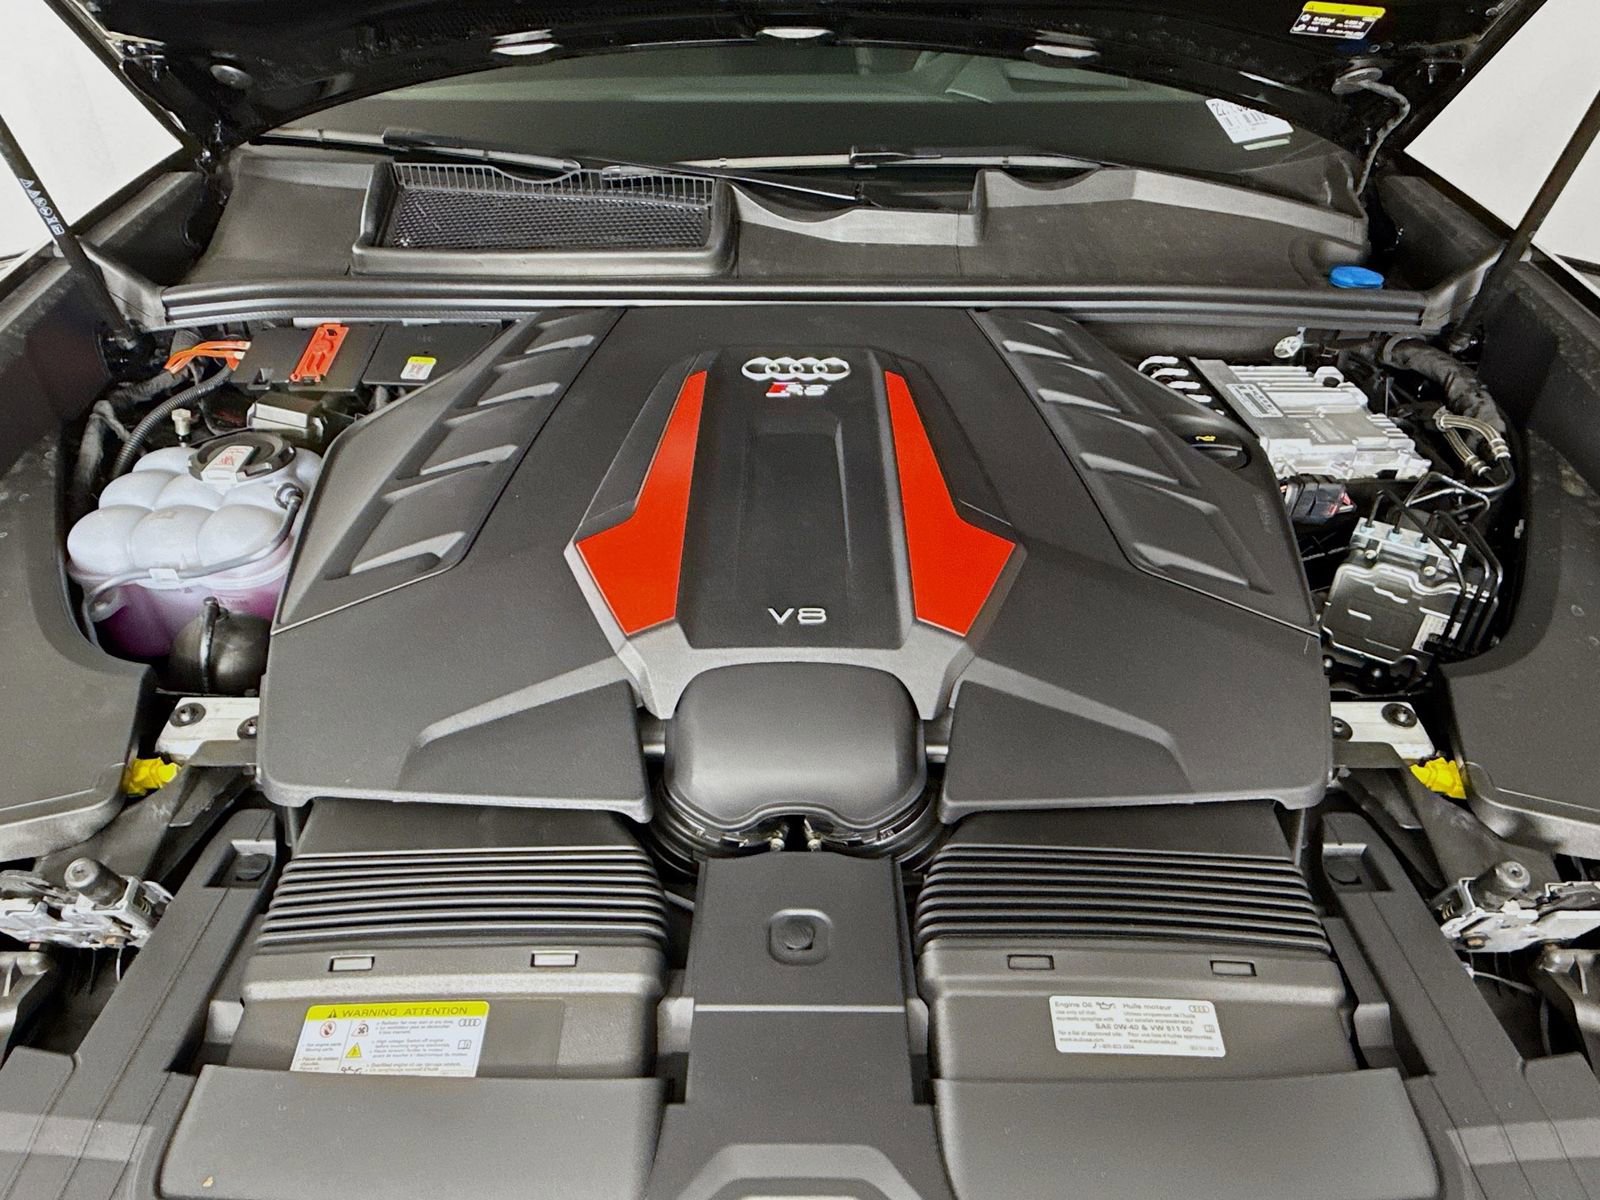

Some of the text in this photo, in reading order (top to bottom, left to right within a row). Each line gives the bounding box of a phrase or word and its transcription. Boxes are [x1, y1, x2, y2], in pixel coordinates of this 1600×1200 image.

[767, 607, 827, 625] V8
[342, 1006, 468, 1017] WARNING ATTENTION
